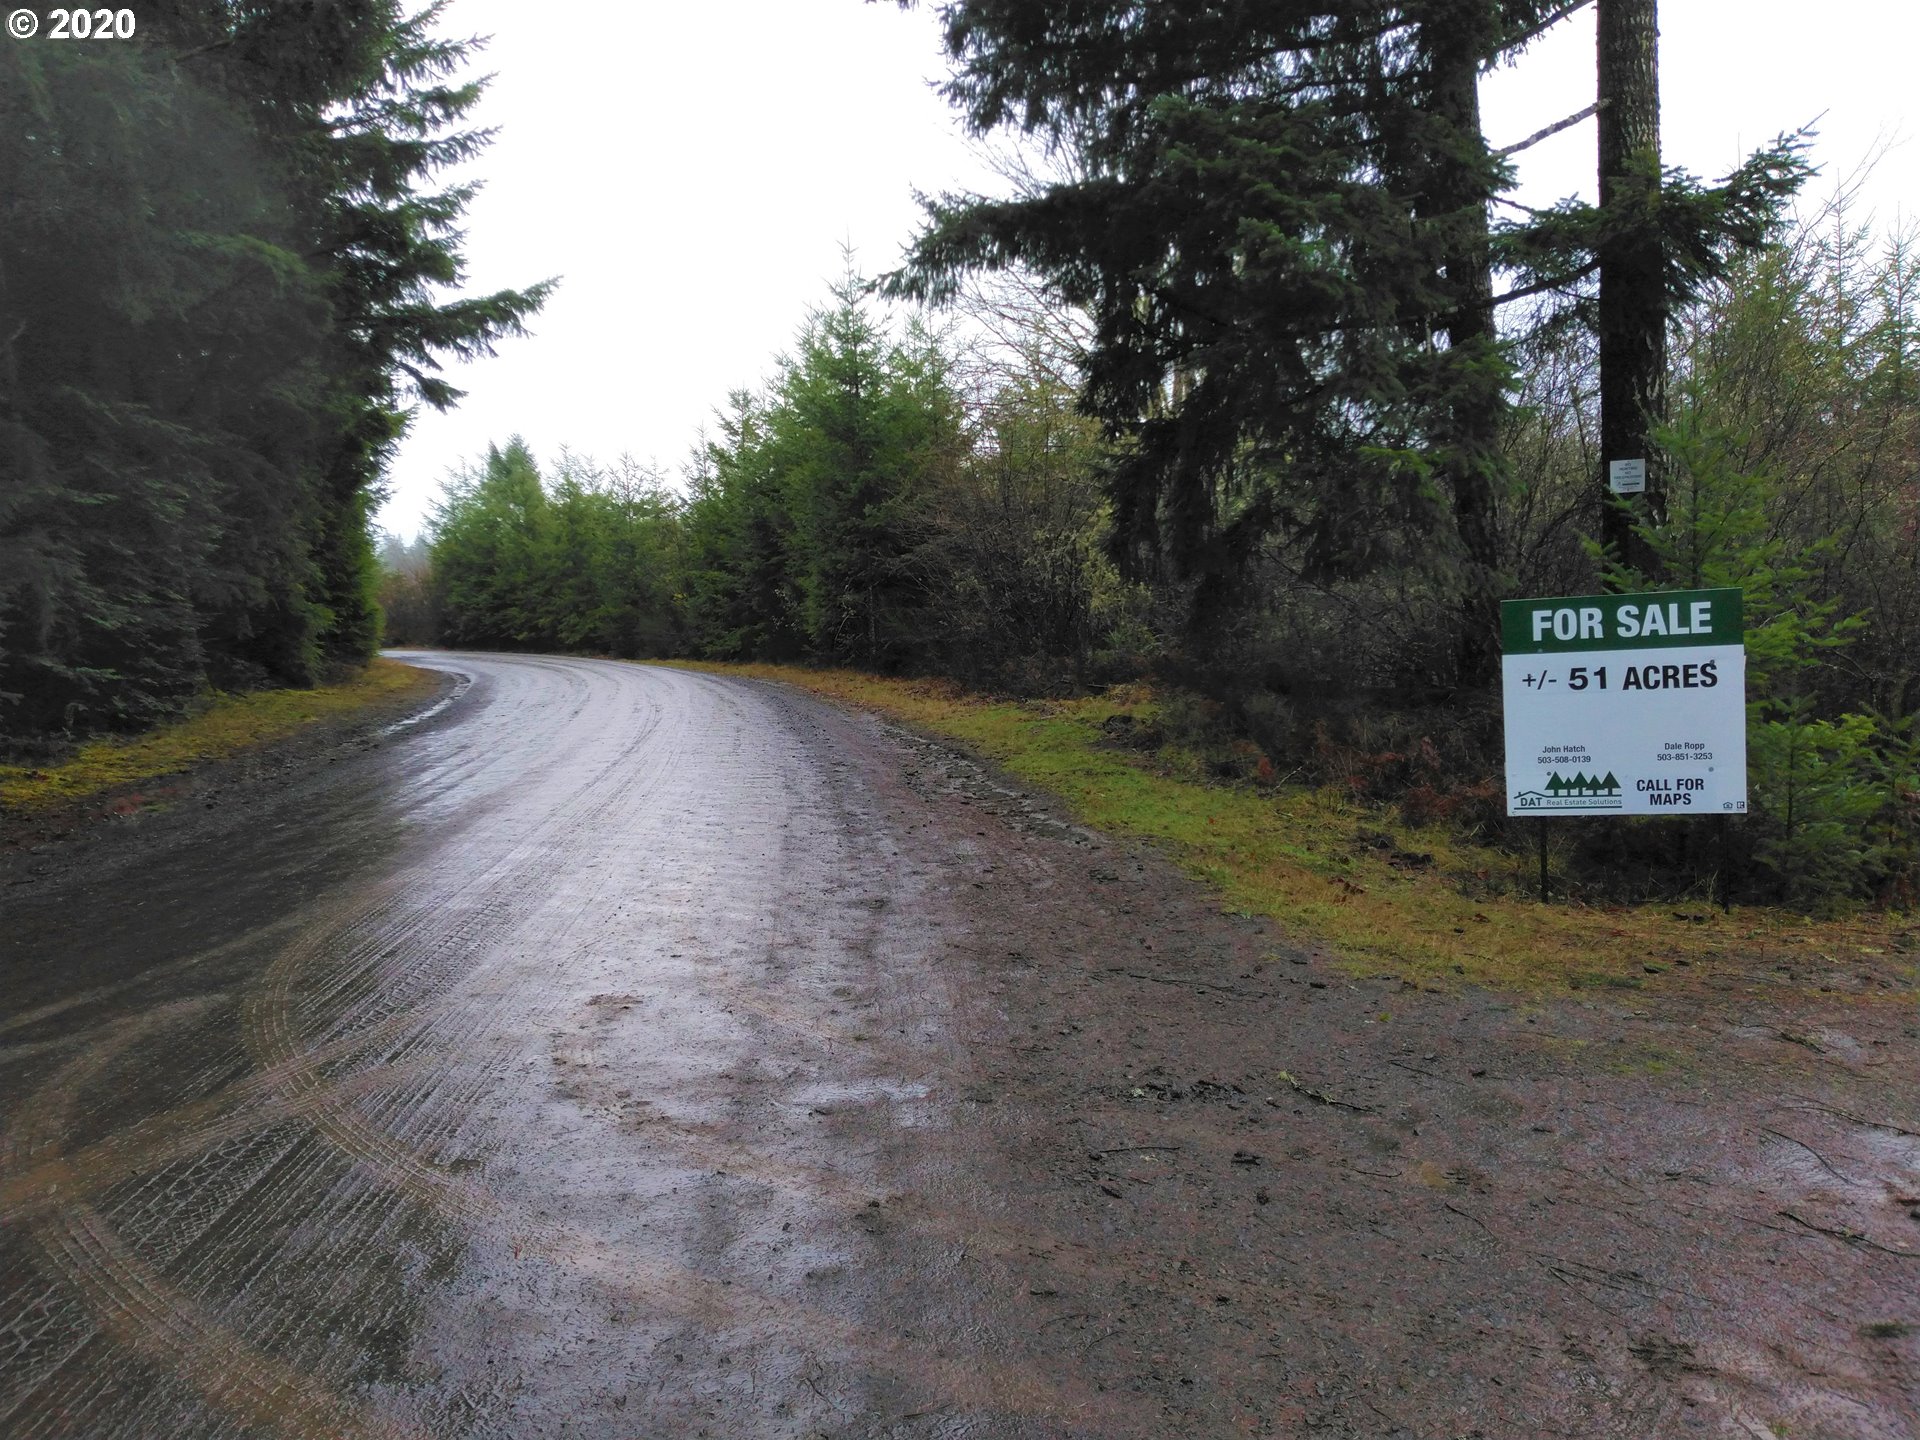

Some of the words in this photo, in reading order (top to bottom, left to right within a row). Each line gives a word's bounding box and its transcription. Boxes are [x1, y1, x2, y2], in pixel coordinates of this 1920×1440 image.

[1531, 607, 1604, 642] FOR
[1616, 600, 1713, 638] SALE
[1521, 670, 1557, 690] +/-
[1567, 666, 1608, 691] 51
[1622, 662, 1718, 691] ACRES
[1542, 745, 1562, 754] John
[1563, 744, 1586, 753] Hatch
[1664, 742, 1683, 751] Dale
[1684, 742, 1706, 752] Ropp
[1537, 755, 1591, 764] 503-508-0139
[1656, 752, 1713, 761] 503-851-3253
[1636, 779, 1672, 792] CALL
[1676, 778, 1705, 791] FOR
[1520, 797, 1543, 807] DAT
[1564, 798, 1587, 806] Estate
[1588, 797, 1622, 806] Solutions
[1649, 793, 1692, 806] MAPS
